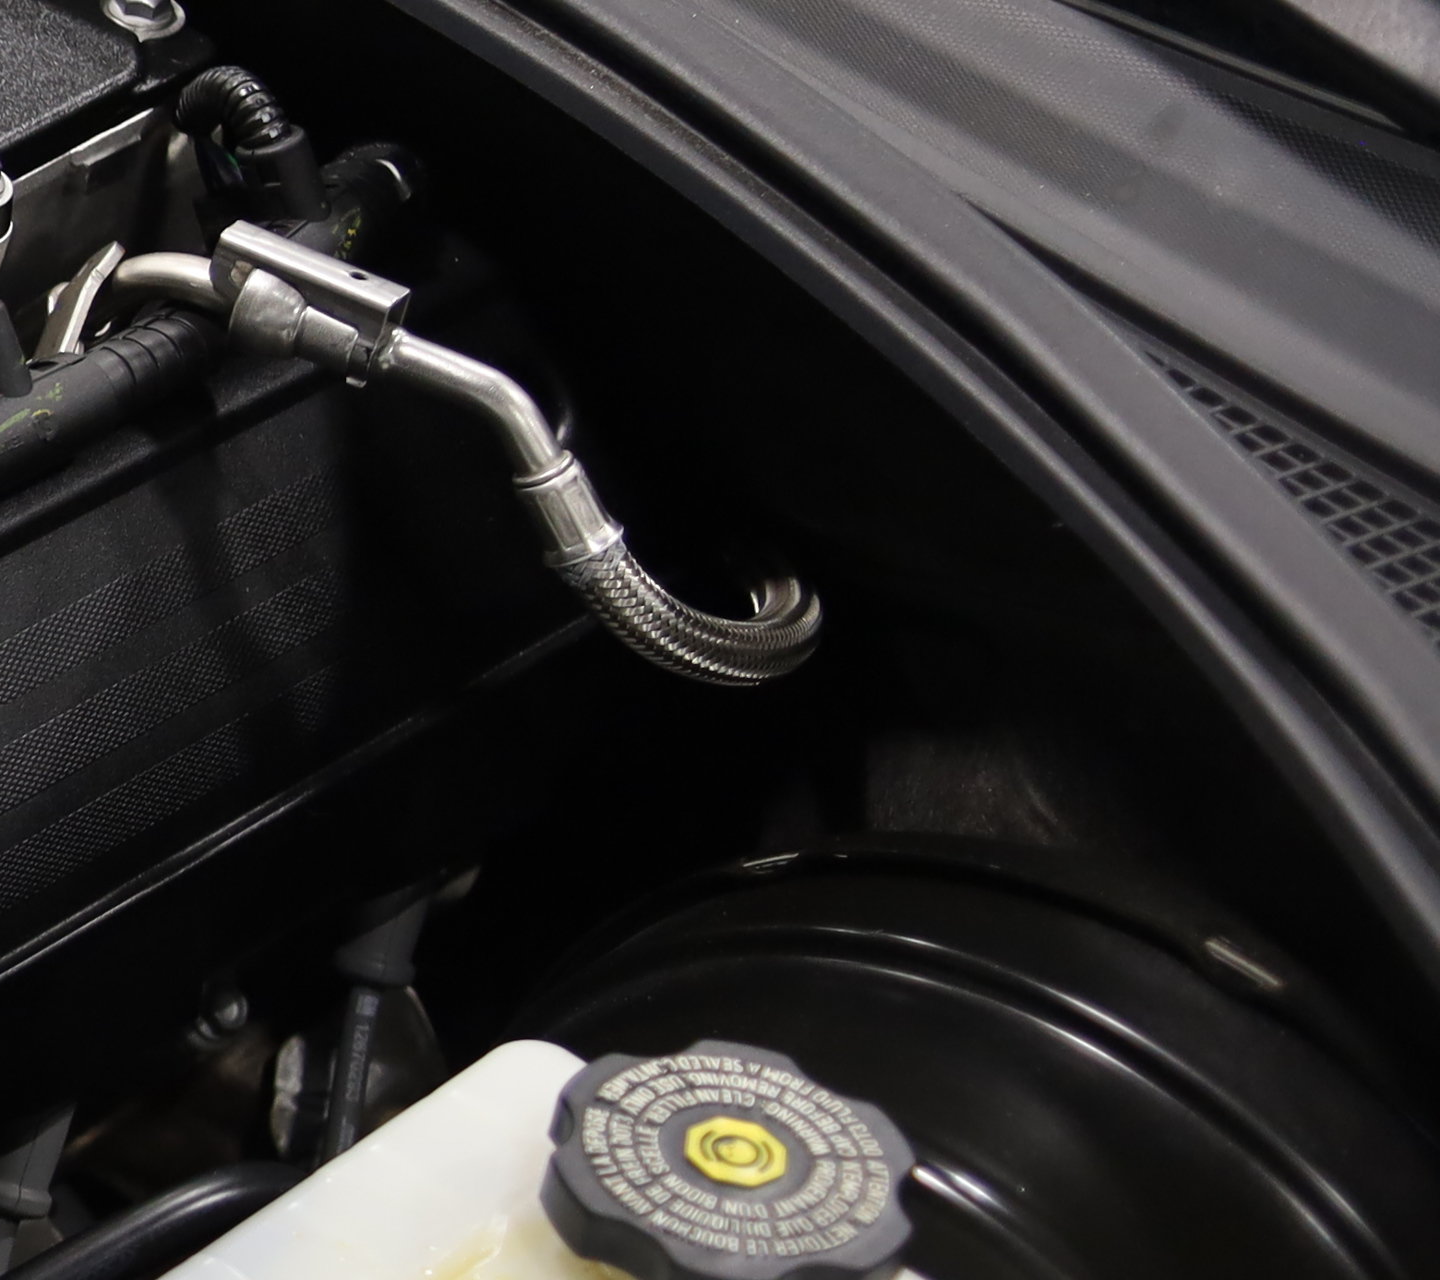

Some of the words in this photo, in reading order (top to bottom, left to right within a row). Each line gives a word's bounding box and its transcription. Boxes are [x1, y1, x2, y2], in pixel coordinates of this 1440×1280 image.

[671, 1055, 744, 1073] SEALED
[747, 1061, 761, 1076] A
[645, 1075, 686, 1095] USE
[761, 1065, 816, 1095] FROM
[616, 1084, 657, 1116] ONLY
[693, 1088, 757, 1109] CLEAN
[779, 1090, 843, 1134] BEFORE
[809, 1088, 861, 1124] FLUID
[827, 1132, 858, 1157] CAP
[587, 1155, 618, 1175] LA
[611, 1146, 653, 1187] FREIN
[600, 1174, 656, 1217] AVANT
[640, 1183, 673, 1205] DE
[659, 1172, 719, 1210] BIDON
[768, 1159, 835, 1217] PROVENANT
[666, 1198, 740, 1234] LIQUIDE
[745, 1221, 773, 1236] DU
[772, 1215, 816, 1236] QUE
[644, 1208, 739, 1252] BOUCHON
[745, 1238, 770, 1256] LE
